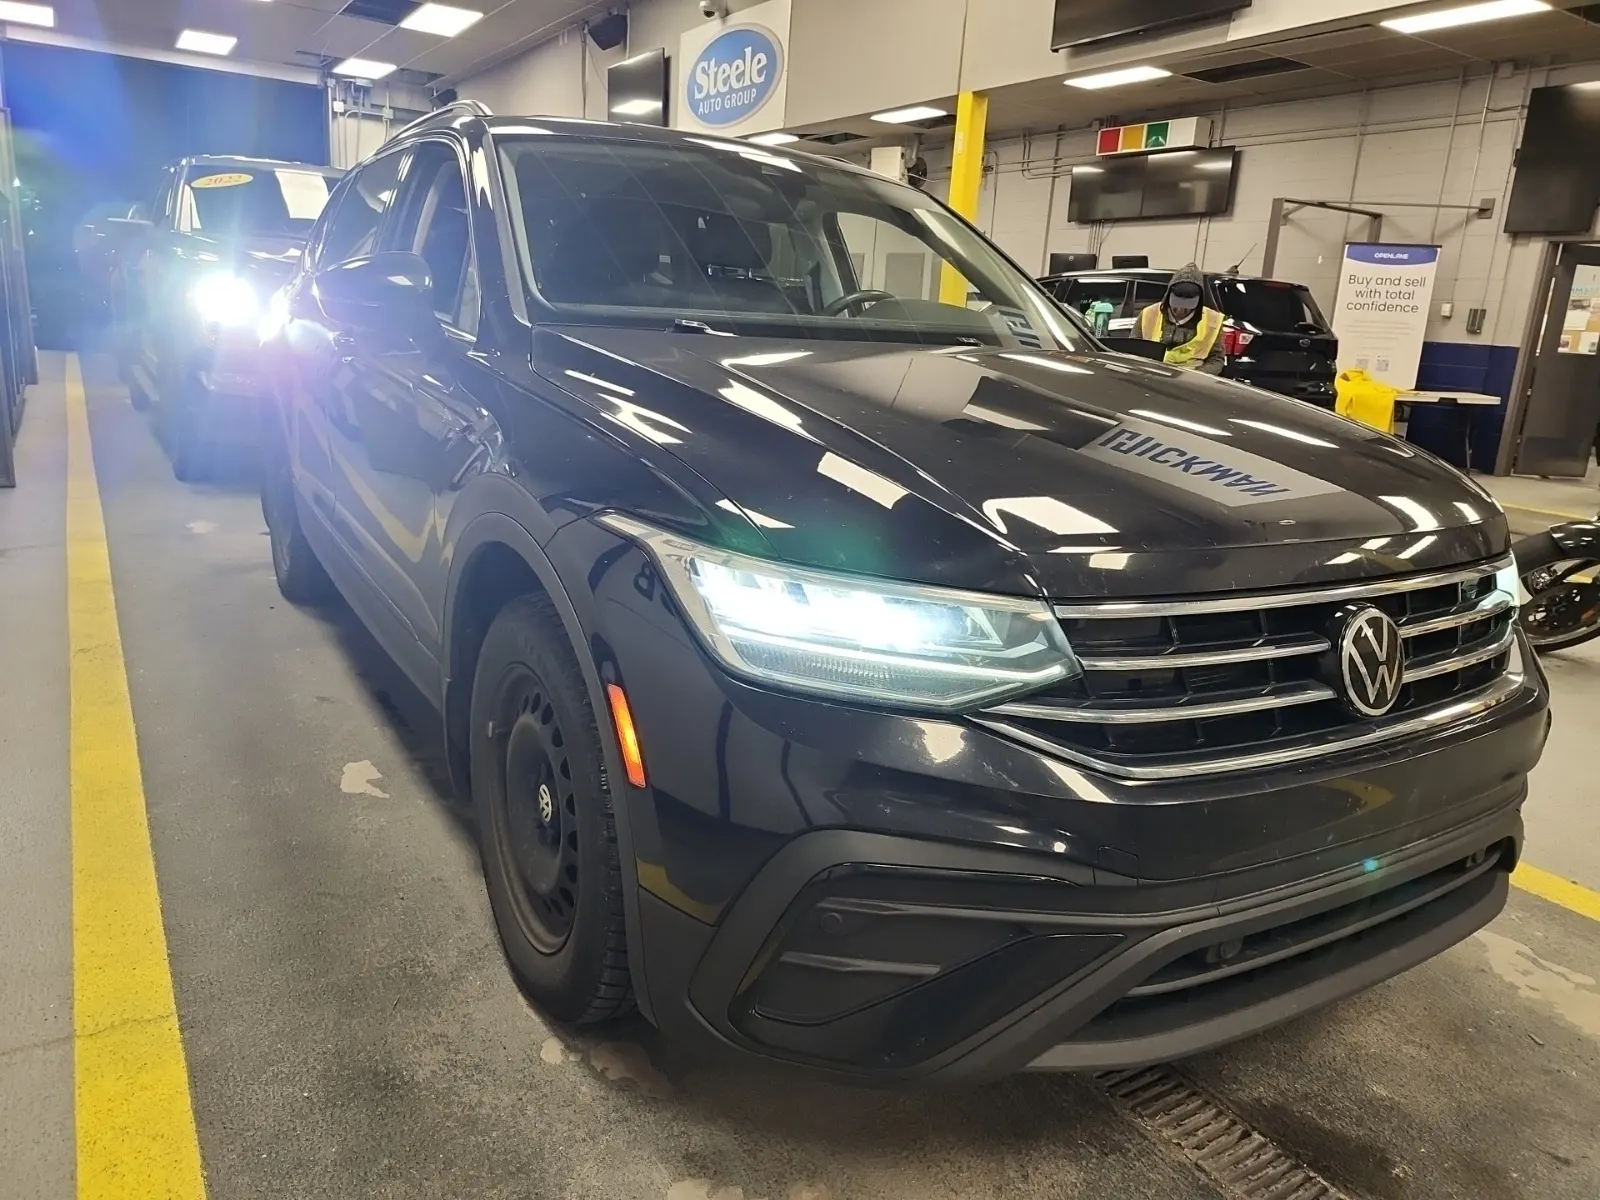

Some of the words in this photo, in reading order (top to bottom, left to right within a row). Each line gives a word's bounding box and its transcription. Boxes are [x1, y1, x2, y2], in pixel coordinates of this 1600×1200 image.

[694, 46, 768, 100] Steele
[698, 97, 721, 115] AUTO
[724, 88, 757, 109] GROUP
[204, 175, 242, 186] 2022
[1374, 252, 1409, 260] OPENLANE
[1348, 274, 1373, 287] Buy
[1375, 275, 1402, 287] and
[1404, 276, 1427, 288] sell
[1354, 287, 1382, 300] with
[1385, 289, 1415, 301] total
[1346, 301, 1419, 314] confidence
